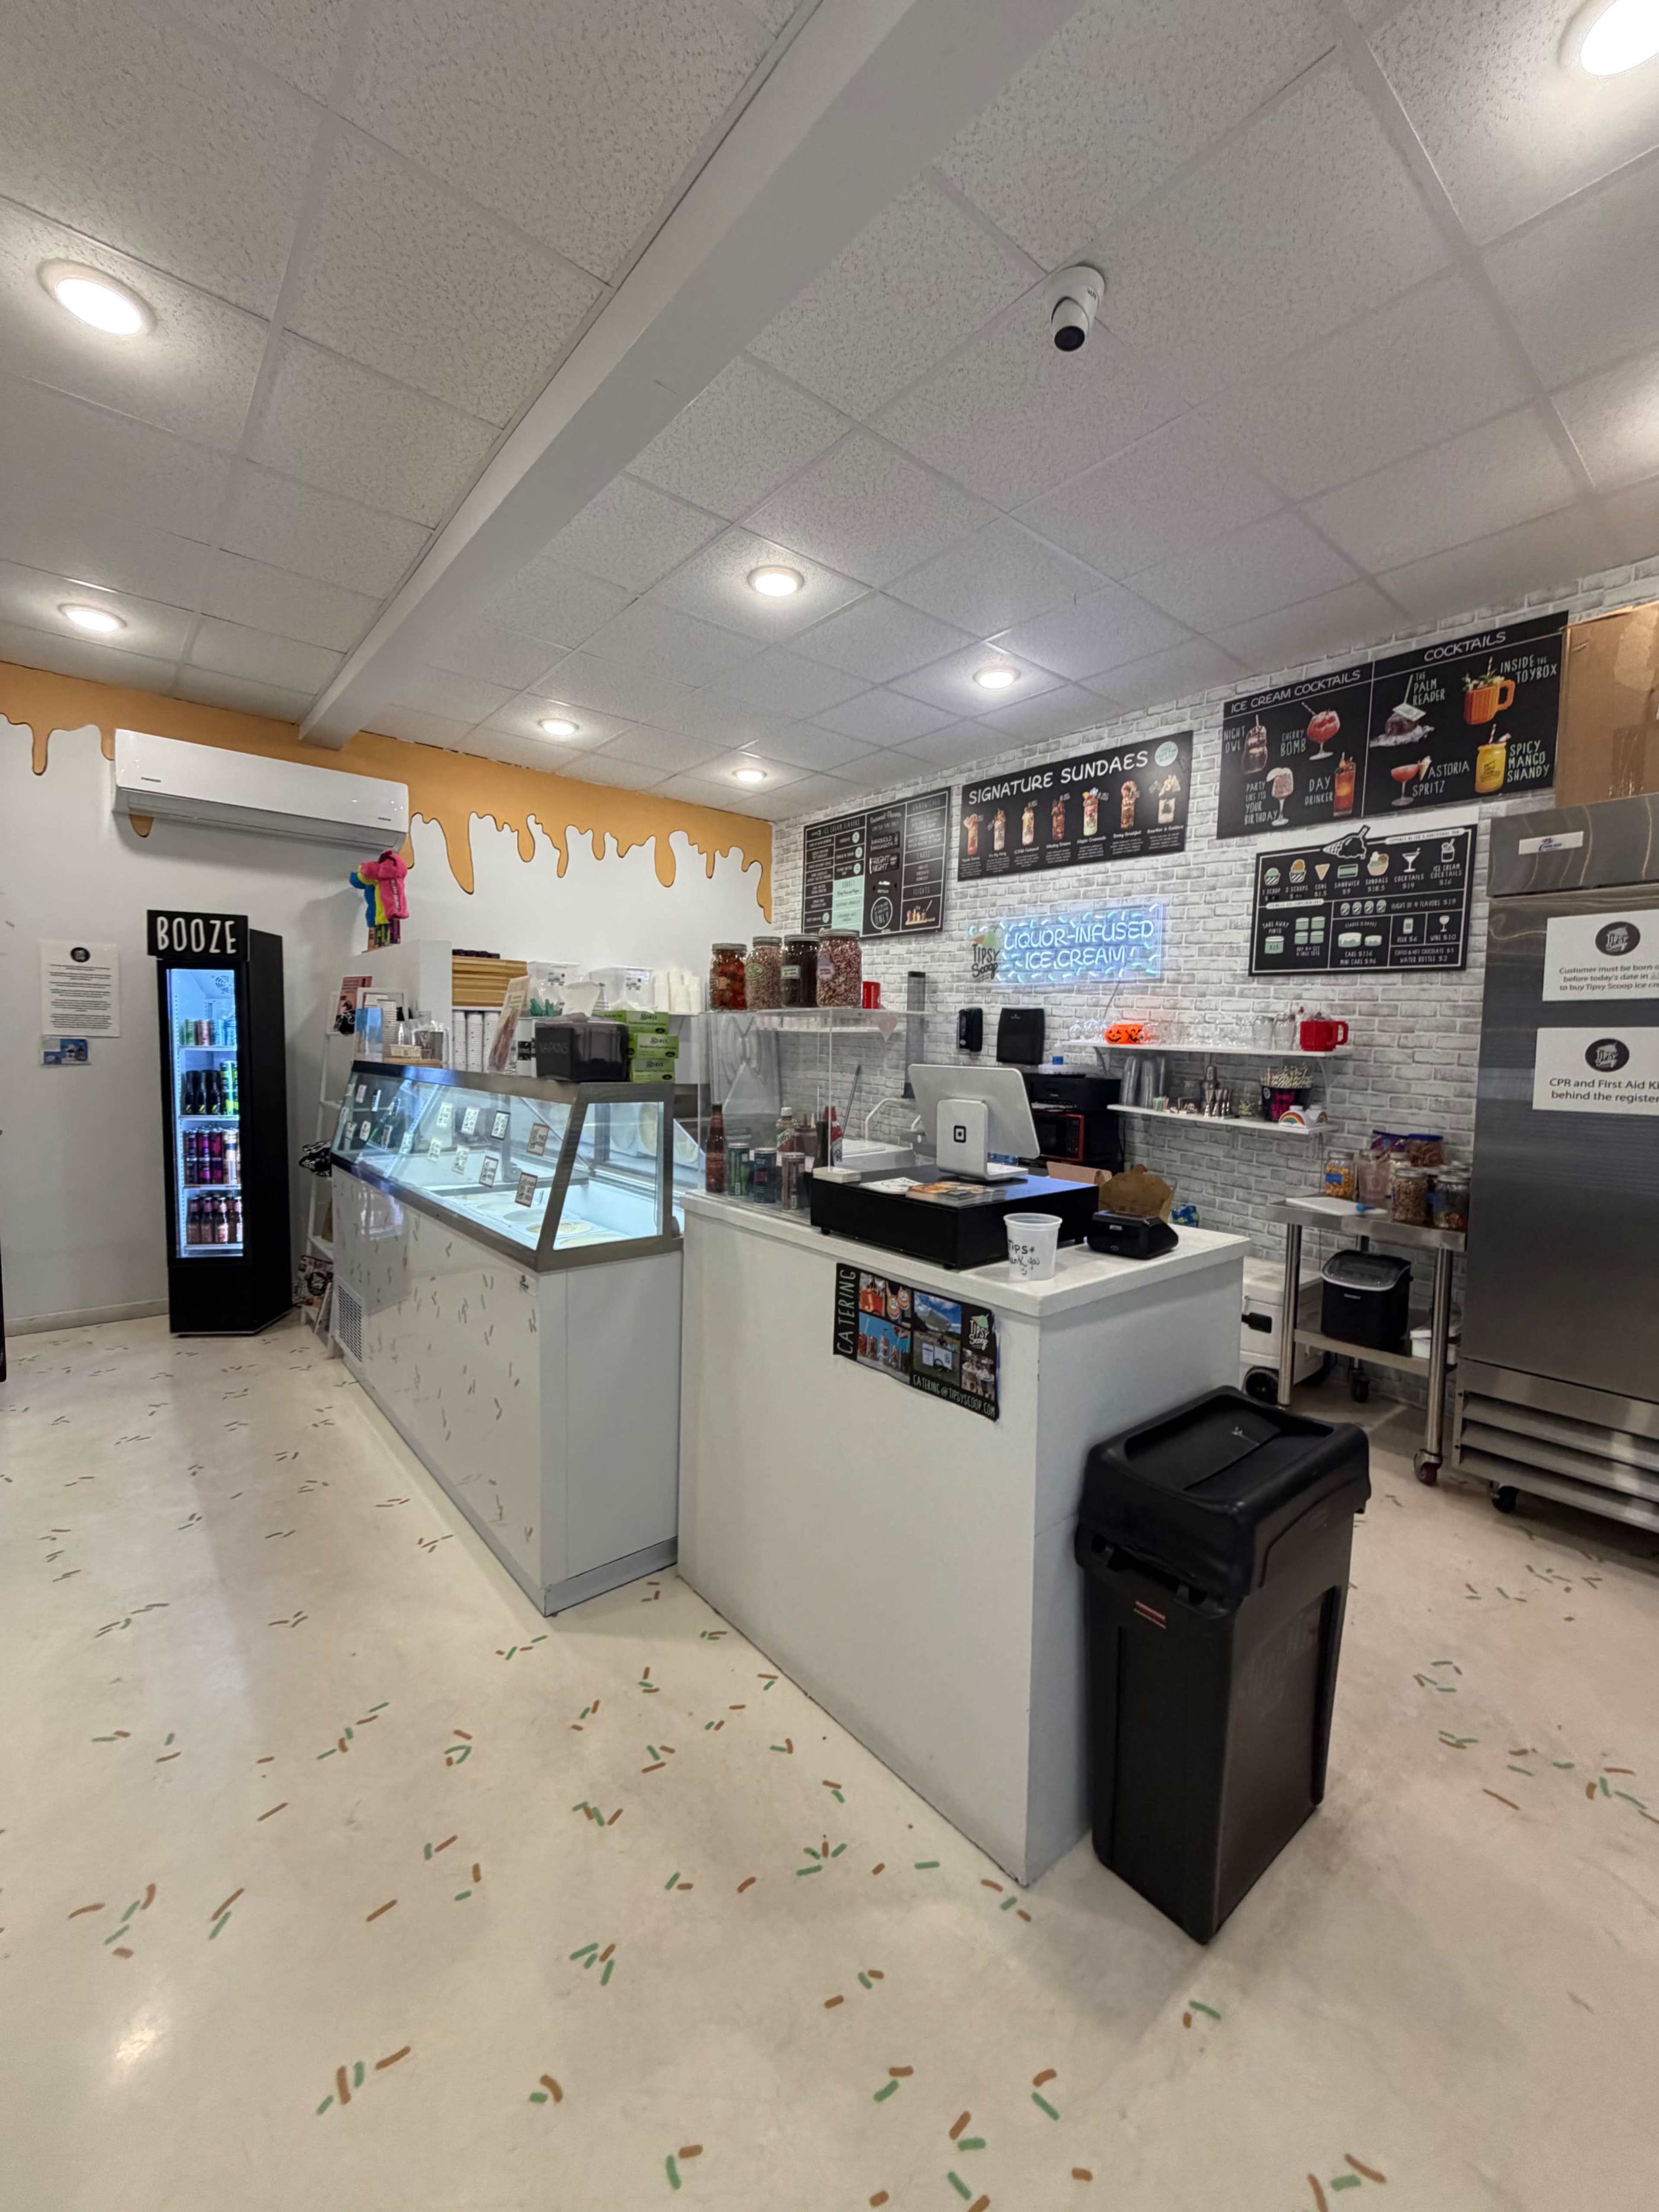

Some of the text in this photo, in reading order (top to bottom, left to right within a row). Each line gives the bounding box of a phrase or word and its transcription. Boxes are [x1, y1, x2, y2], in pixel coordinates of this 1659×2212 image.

[1424, 631, 1506, 662] COCKTAILS
[1500, 654, 1535, 673] INSIDE
[1416, 672, 1425, 681] THE
[1516, 664, 1557, 684] TOYBOX
[1231, 670, 1360, 713] ICE CREAM COCKTAILS
[1414, 678, 1437, 693] PALM
[1413, 689, 1445, 706] READER
[1224, 726, 1246, 741] NIGHT
[1282, 729, 1305, 741] CHERRY
[1225, 740, 1240, 754] OWL
[1281, 738, 1306, 757] BOMB
[1510, 740, 1541, 757] SPICY
[969, 772, 1053, 805] SIGNATURE
[1060, 751, 1148, 784] SUNDAES
[1428, 761, 1470, 779] ASTORIA
[1507, 764, 1550, 783] SHANDY
[1246, 781, 1265, 791] PARTY
[1309, 776, 1331, 793] DAY
[1412, 780, 1445, 797] SPRITZ
[1246, 801, 1262, 813] YOUR
[1305, 792, 1333, 806] DRINKER
[1244, 810, 1278, 826] BIRTHDAY
[1394, 874, 1424, 882] COCKTAILS
[1430, 870, 1462, 879] COCKTAILS
[1334, 880, 1360, 888] SANDWICH
[157, 916, 236, 954] BOOZE
[1004, 920, 1154, 951] LIQUOR-INFUSED
[972, 944, 1001, 964] TIPSY
[1025, 946, 1126, 969] ICE CREAM
[971, 962, 998, 979] Scoop
[1549, 1078, 1571, 1087] CPR
[1573, 1079, 1595, 1088] and
[1599, 1079, 1622, 1089] First
[1625, 1080, 1645, 1089] Aid
[1551, 1090, 1590, 1100] behind
[1593, 1092, 1612, 1101] the
[836, 1270, 856, 1354] CATERING
[969, 1320, 989, 1339] TIPSY
[969, 1334, 988, 1351] Scoop
